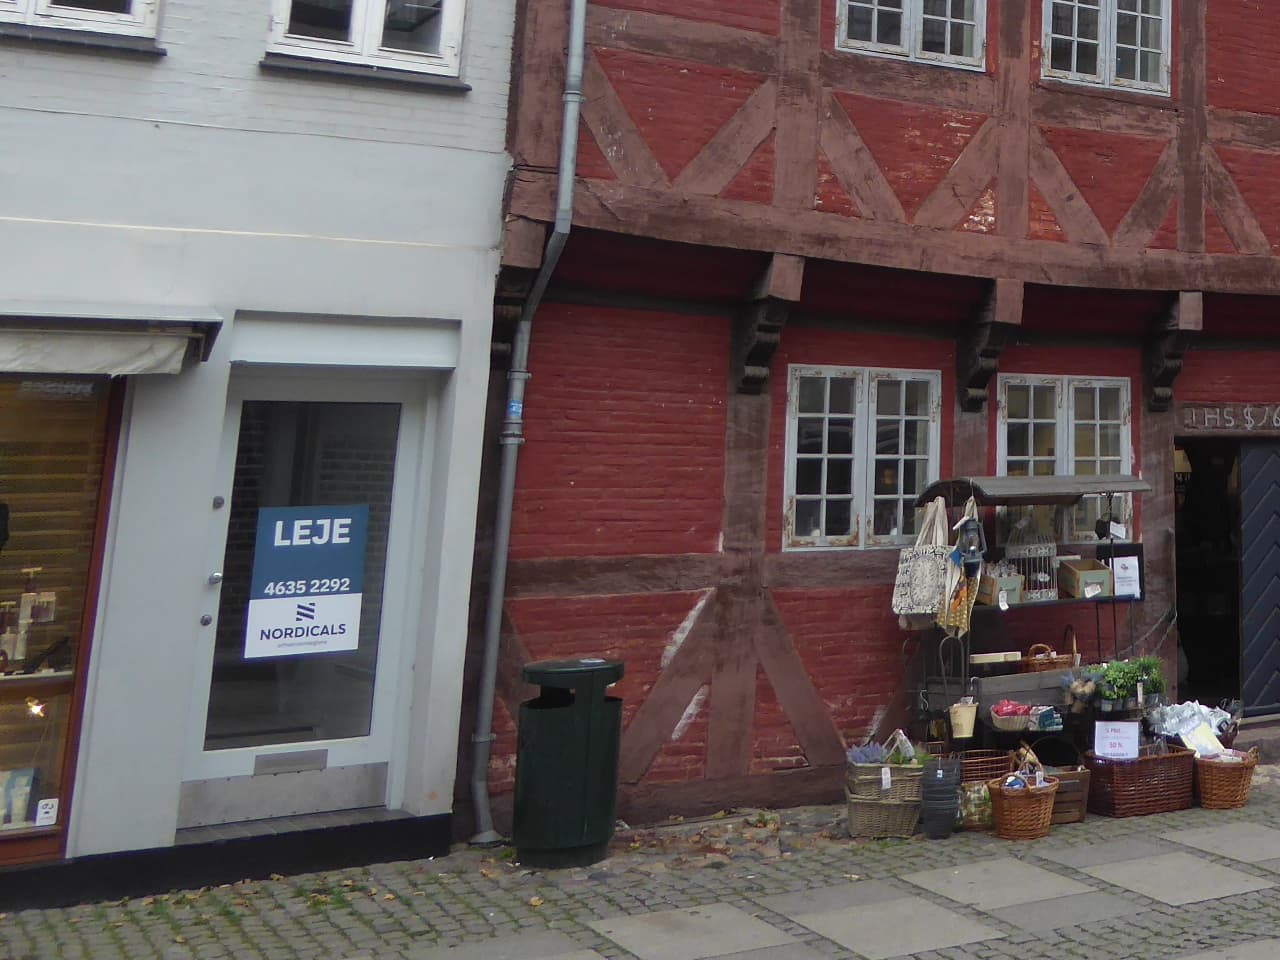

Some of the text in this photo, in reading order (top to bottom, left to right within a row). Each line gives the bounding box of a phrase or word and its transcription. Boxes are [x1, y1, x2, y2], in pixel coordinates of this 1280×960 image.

[273, 518, 352, 547] LEJE
[264, 577, 351, 596] 4635 2292
[259, 623, 347, 641] NORDICALS
